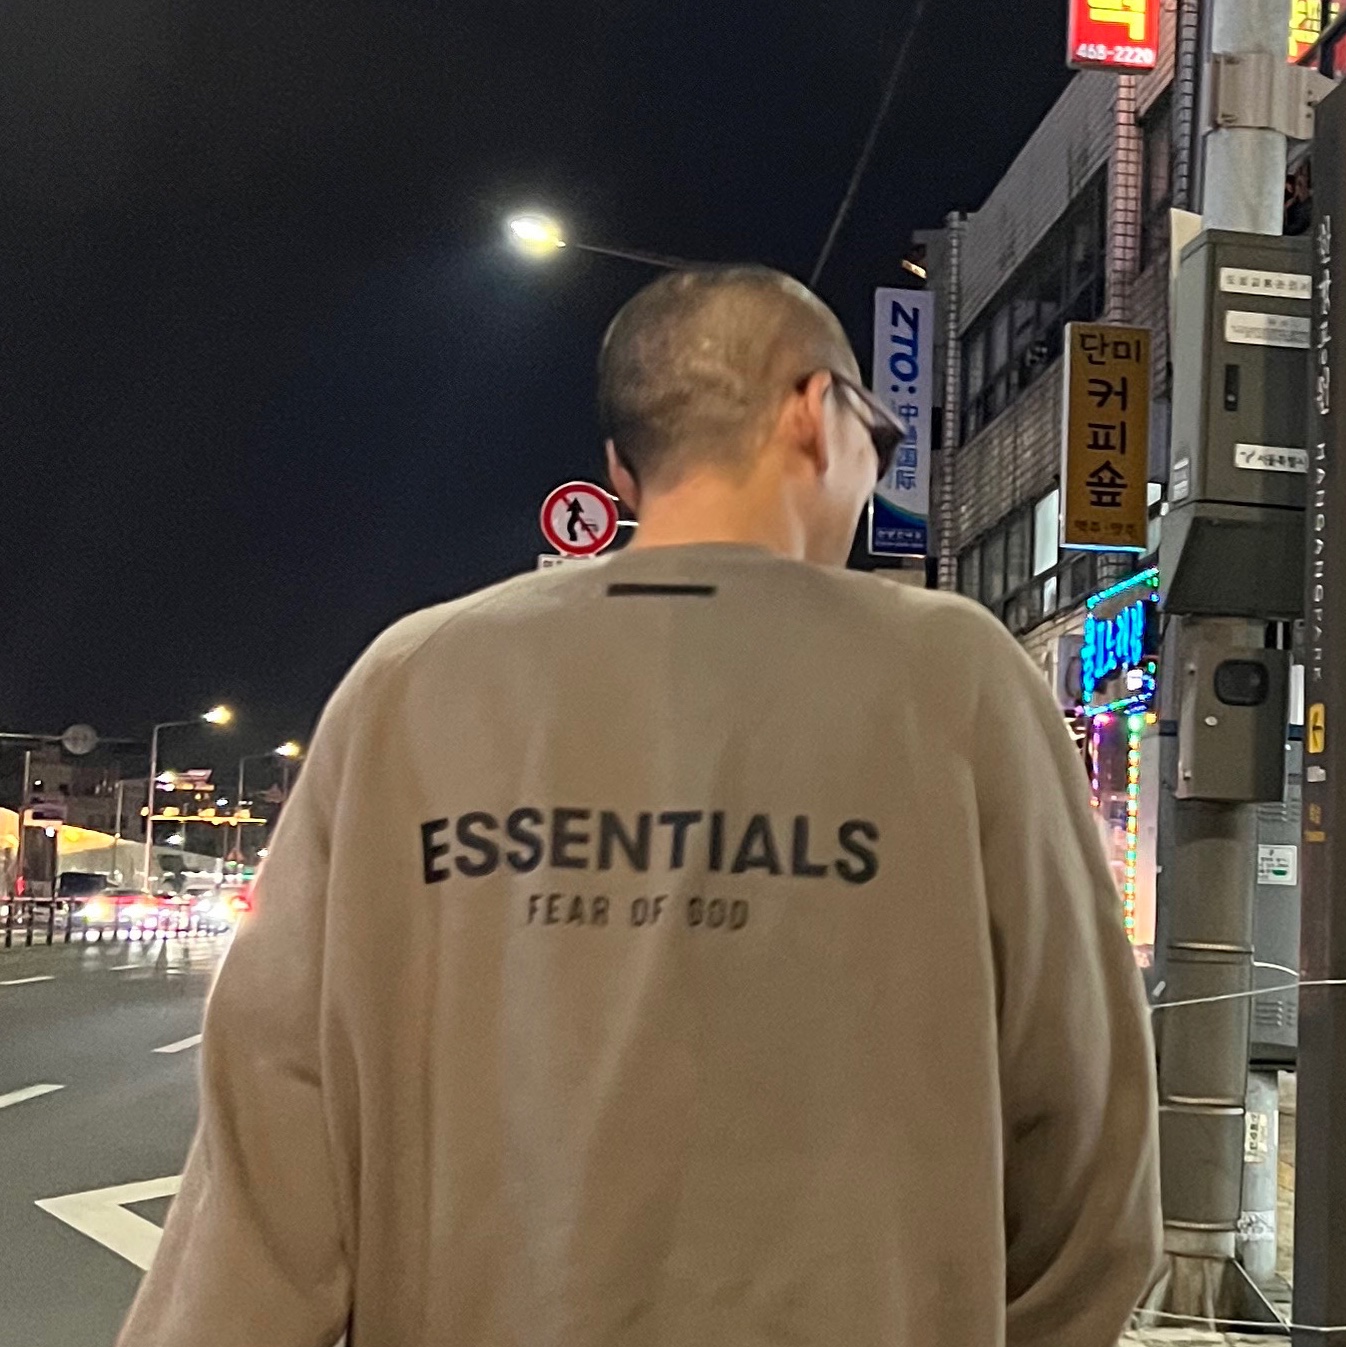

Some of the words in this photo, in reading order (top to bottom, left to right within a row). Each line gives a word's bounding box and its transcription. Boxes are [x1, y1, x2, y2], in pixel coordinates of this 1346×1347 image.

[1079, 333, 1141, 365] 단미
[1086, 376, 1128, 508] 커피숍
[420, 806, 881, 885] ESSENTIALS
[527, 892, 611, 926] FEAR
[630, 893, 669, 929] OF
[686, 896, 750, 931] GOD
